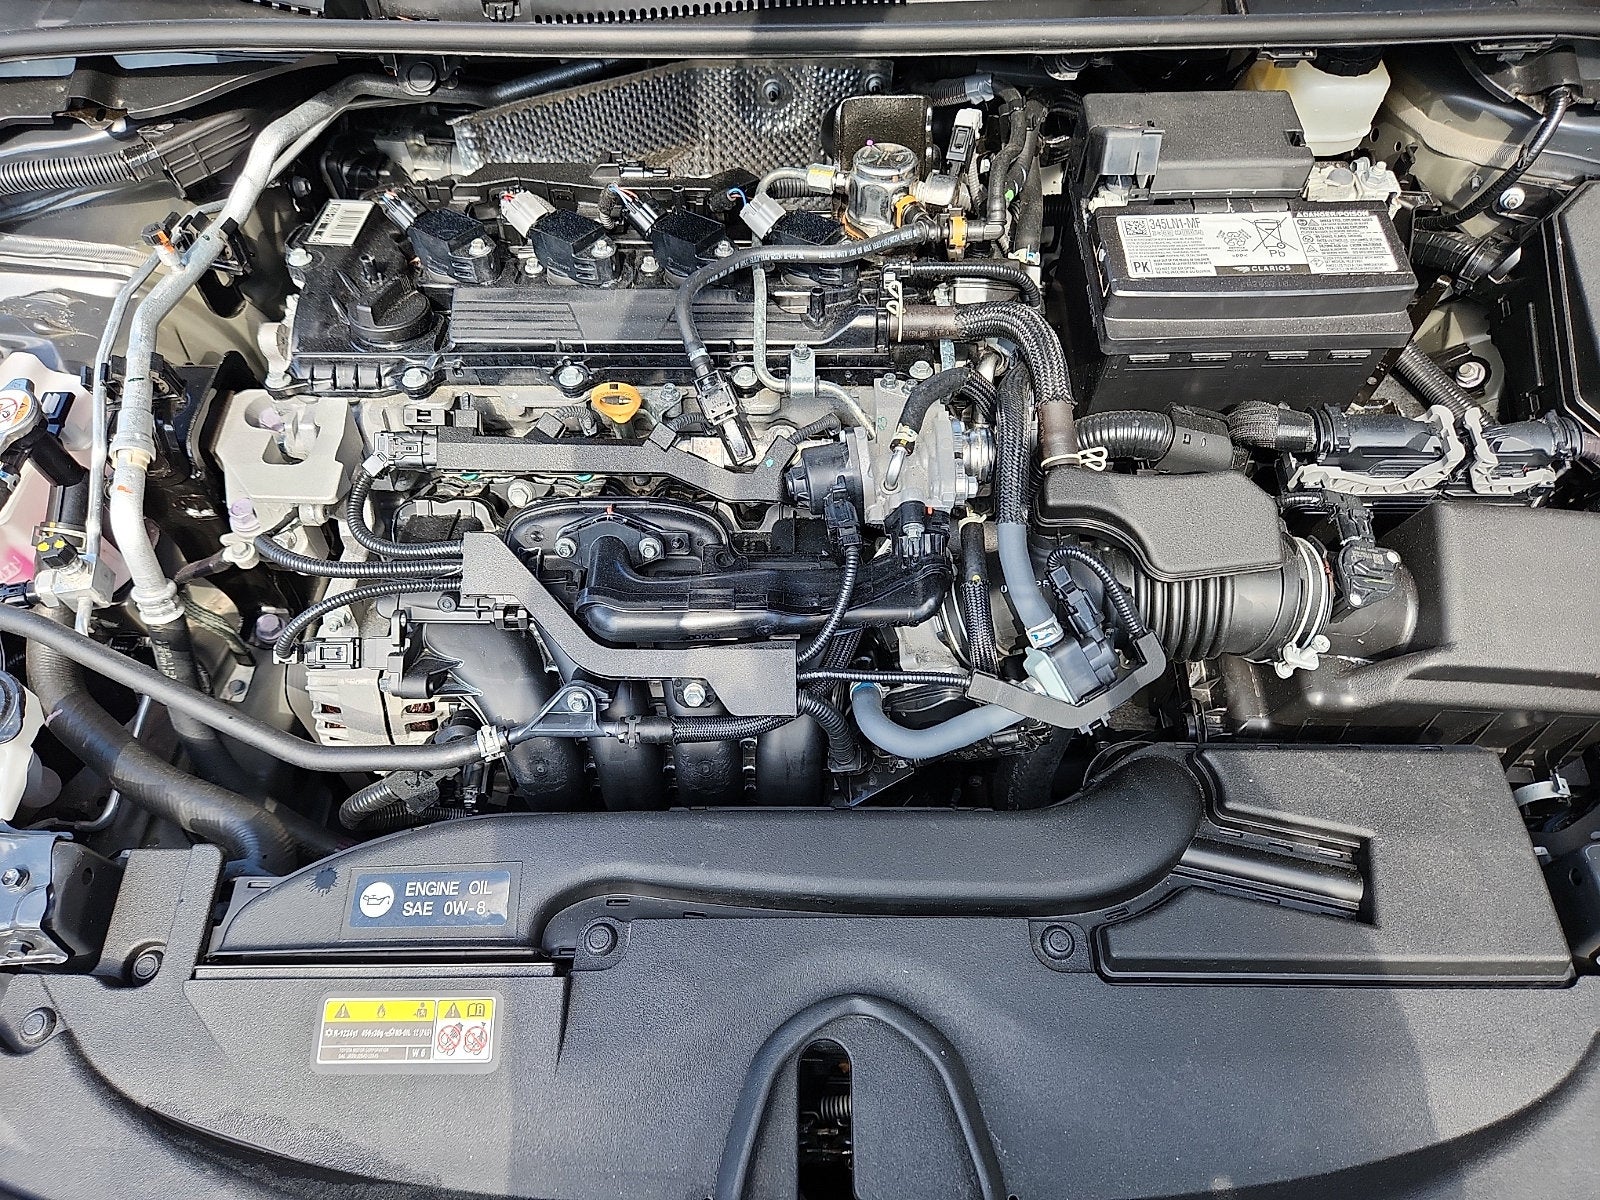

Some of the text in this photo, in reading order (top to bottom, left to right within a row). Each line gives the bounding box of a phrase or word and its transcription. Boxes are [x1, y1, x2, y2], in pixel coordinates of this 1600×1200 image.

[1149, 218, 1201, 230] 345LN1-MF
[1269, 249, 1286, 258] Pb
[1133, 261, 1151, 273] PK
[405, 880, 493, 897] ENGINE OIL
[402, 900, 487, 917] SAE 0W-8
